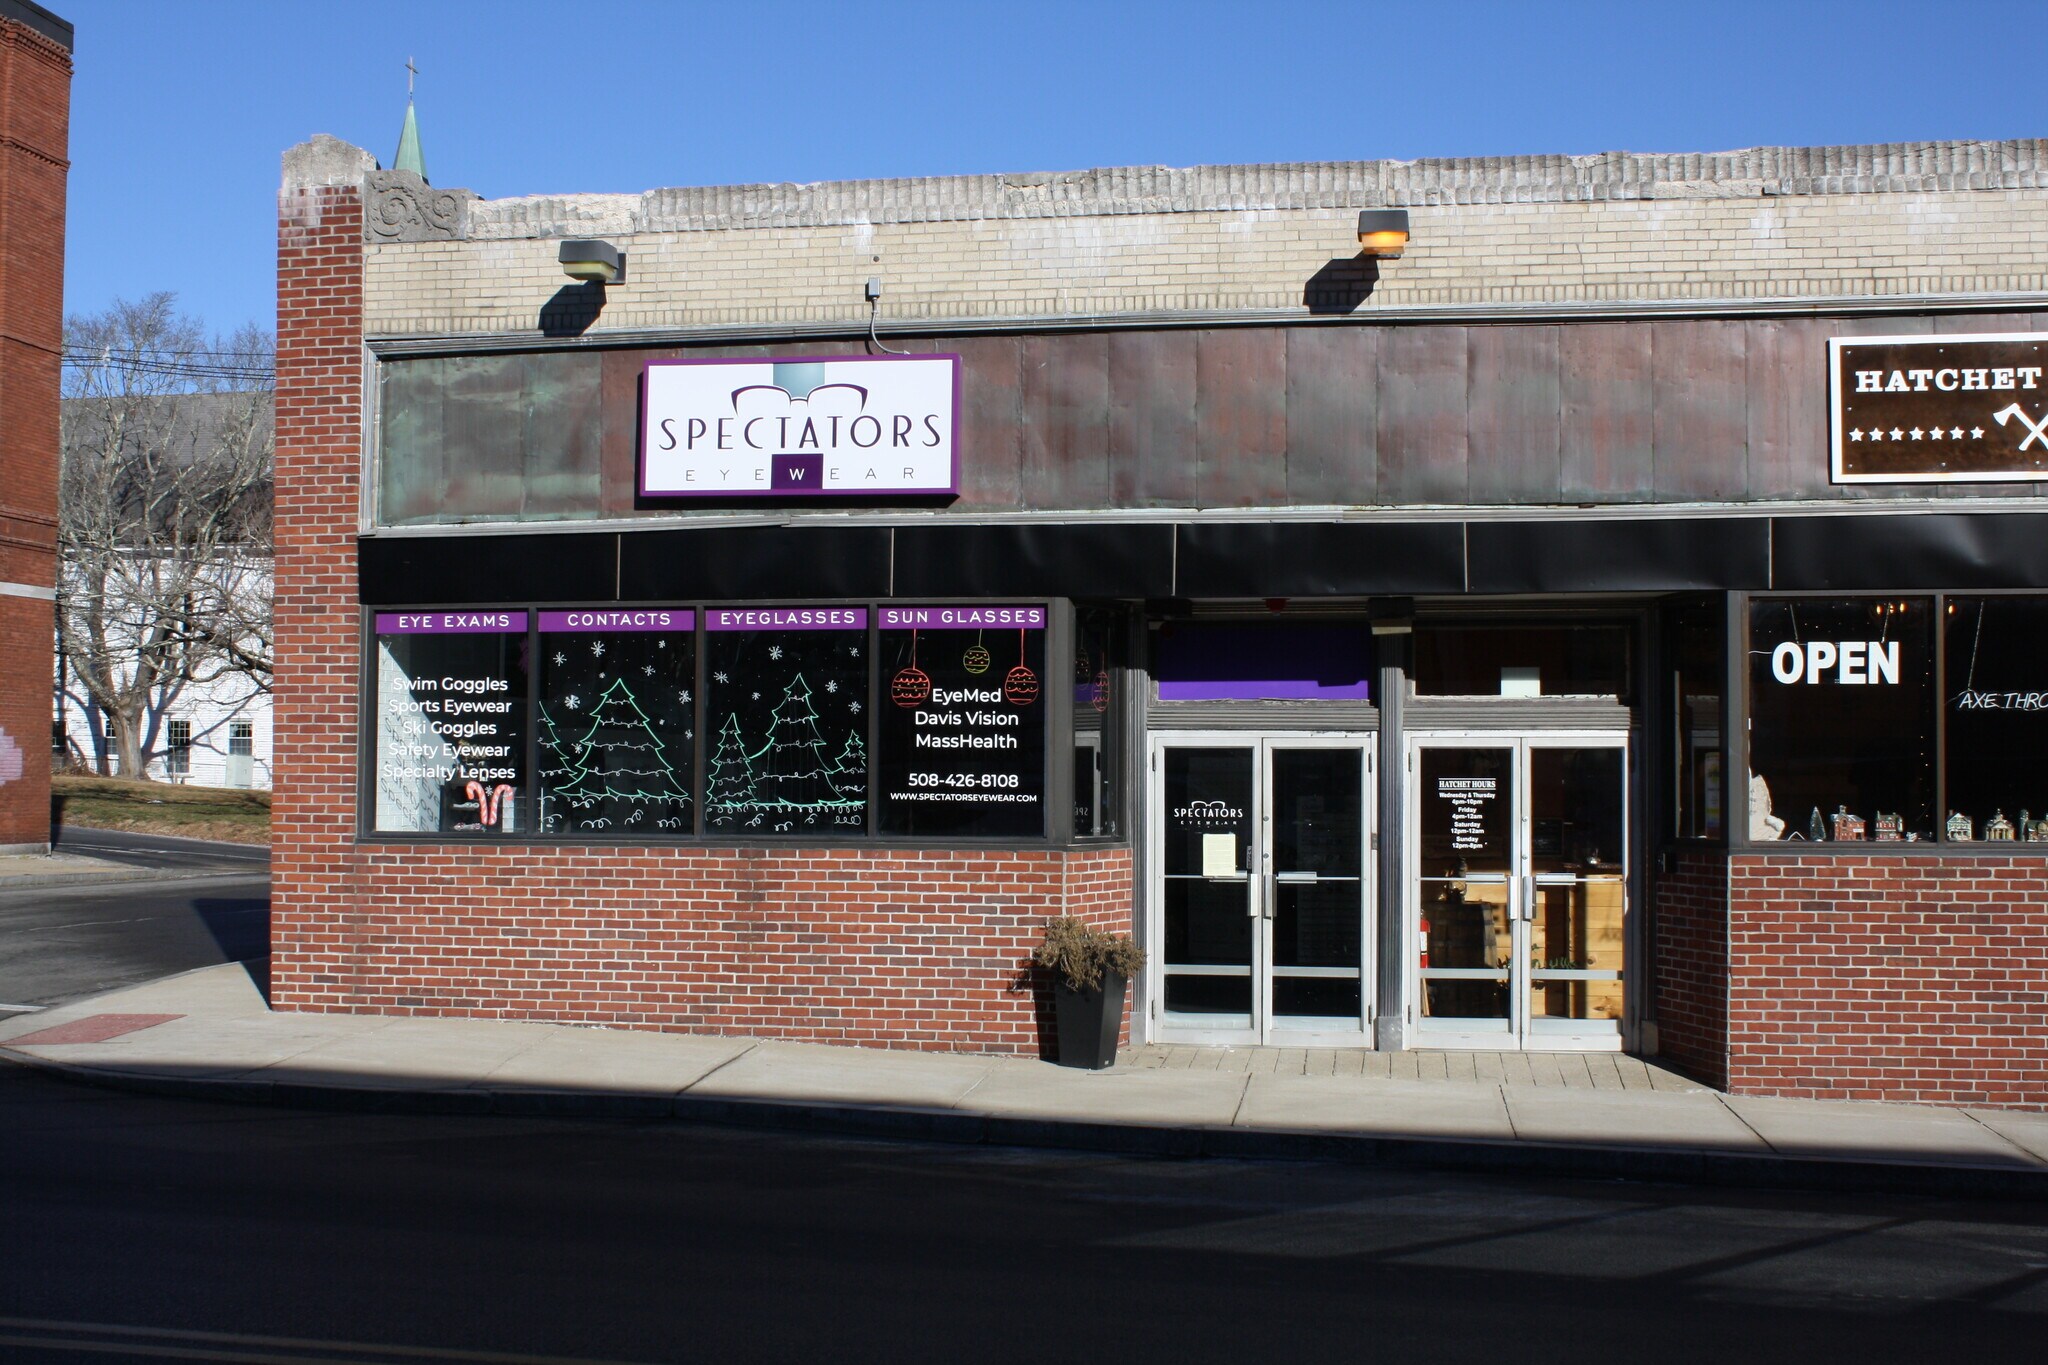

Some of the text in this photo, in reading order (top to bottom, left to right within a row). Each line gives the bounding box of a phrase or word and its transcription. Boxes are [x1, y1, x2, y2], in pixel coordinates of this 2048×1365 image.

[1855, 367, 2042, 393] HATCHET
[659, 413, 941, 450] SPECTATORS
[685, 467, 914, 482] EYEWEAR
[399, 614, 510, 628] EYE EXAMS
[567, 613, 671, 627] CONTACTS
[720, 611, 855, 625] EYEGLASSES
[887, 610, 1041, 624] SUN GLASSES
[1772, 641, 1900, 684] OPEN
[393, 677, 509, 694] Swim Goggles
[932, 688, 1002, 704] EyeMed
[1959, 692, 1998, 709] AXE
[388, 699, 513, 716] Sports Eyewear
[915, 710, 1019, 726] Davis Vision
[402, 721, 498, 738] Ski Goggles
[916, 733, 1017, 749] MassHealth
[388, 743, 511, 759] Safety Eyewear
[383, 764, 516, 781] Specialty Lenses
[908, 773, 1019, 788] 508-426-8108
[1439, 780, 1496, 788] HATCHET HOURS
[1173, 808, 1243, 817] SPECTATORS
[1454, 821, 1481, 829] Saturday
